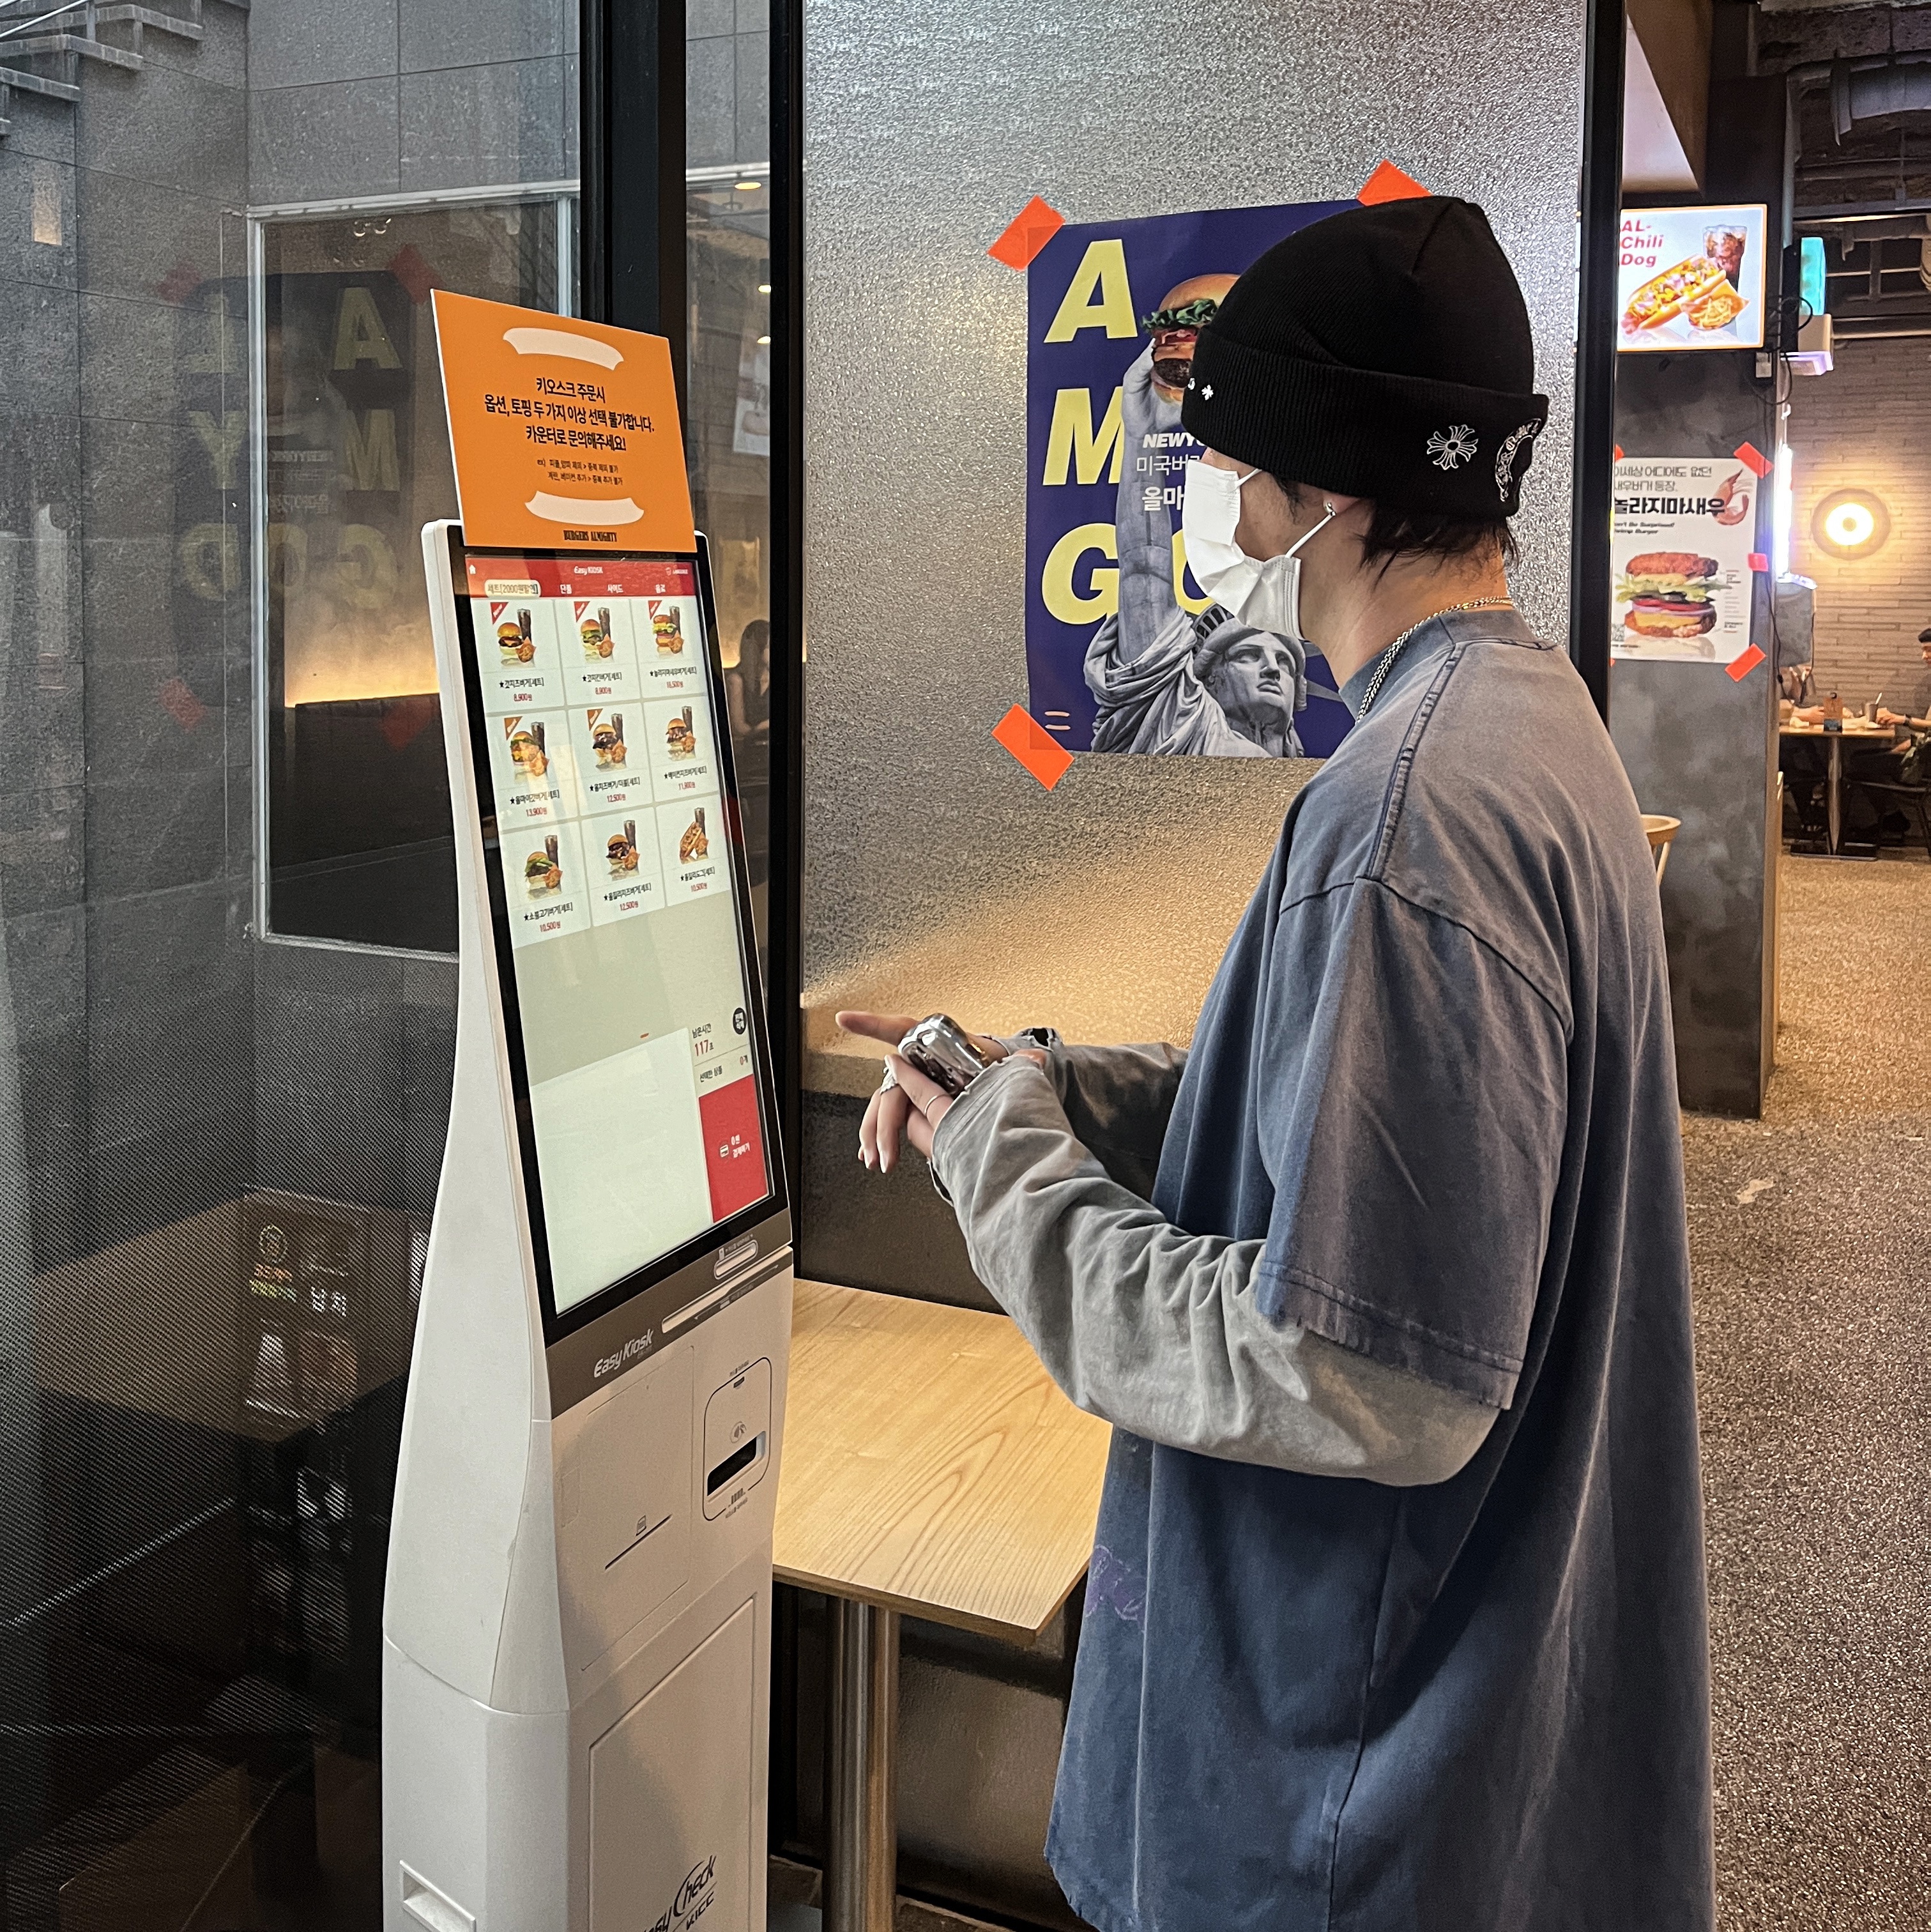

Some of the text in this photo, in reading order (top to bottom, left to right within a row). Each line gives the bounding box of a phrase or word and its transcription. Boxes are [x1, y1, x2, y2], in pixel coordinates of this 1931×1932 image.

[1621, 219, 1652, 232] AL-
[1621, 234, 1664, 250] Chili
[1621, 253, 1658, 268] Dog
[1044, 238, 1138, 343] A
[536, 377, 606, 404] 키오스크 주문시
[484, 394, 655, 433] 옵션, 토핑 두 가지 이상 선택 불가합니다.
[526, 425, 627, 451] 카운터로 문의해주세요!
[1136, 454, 1201, 477] 미국버
[593, 1349, 623, 1378] Easy
